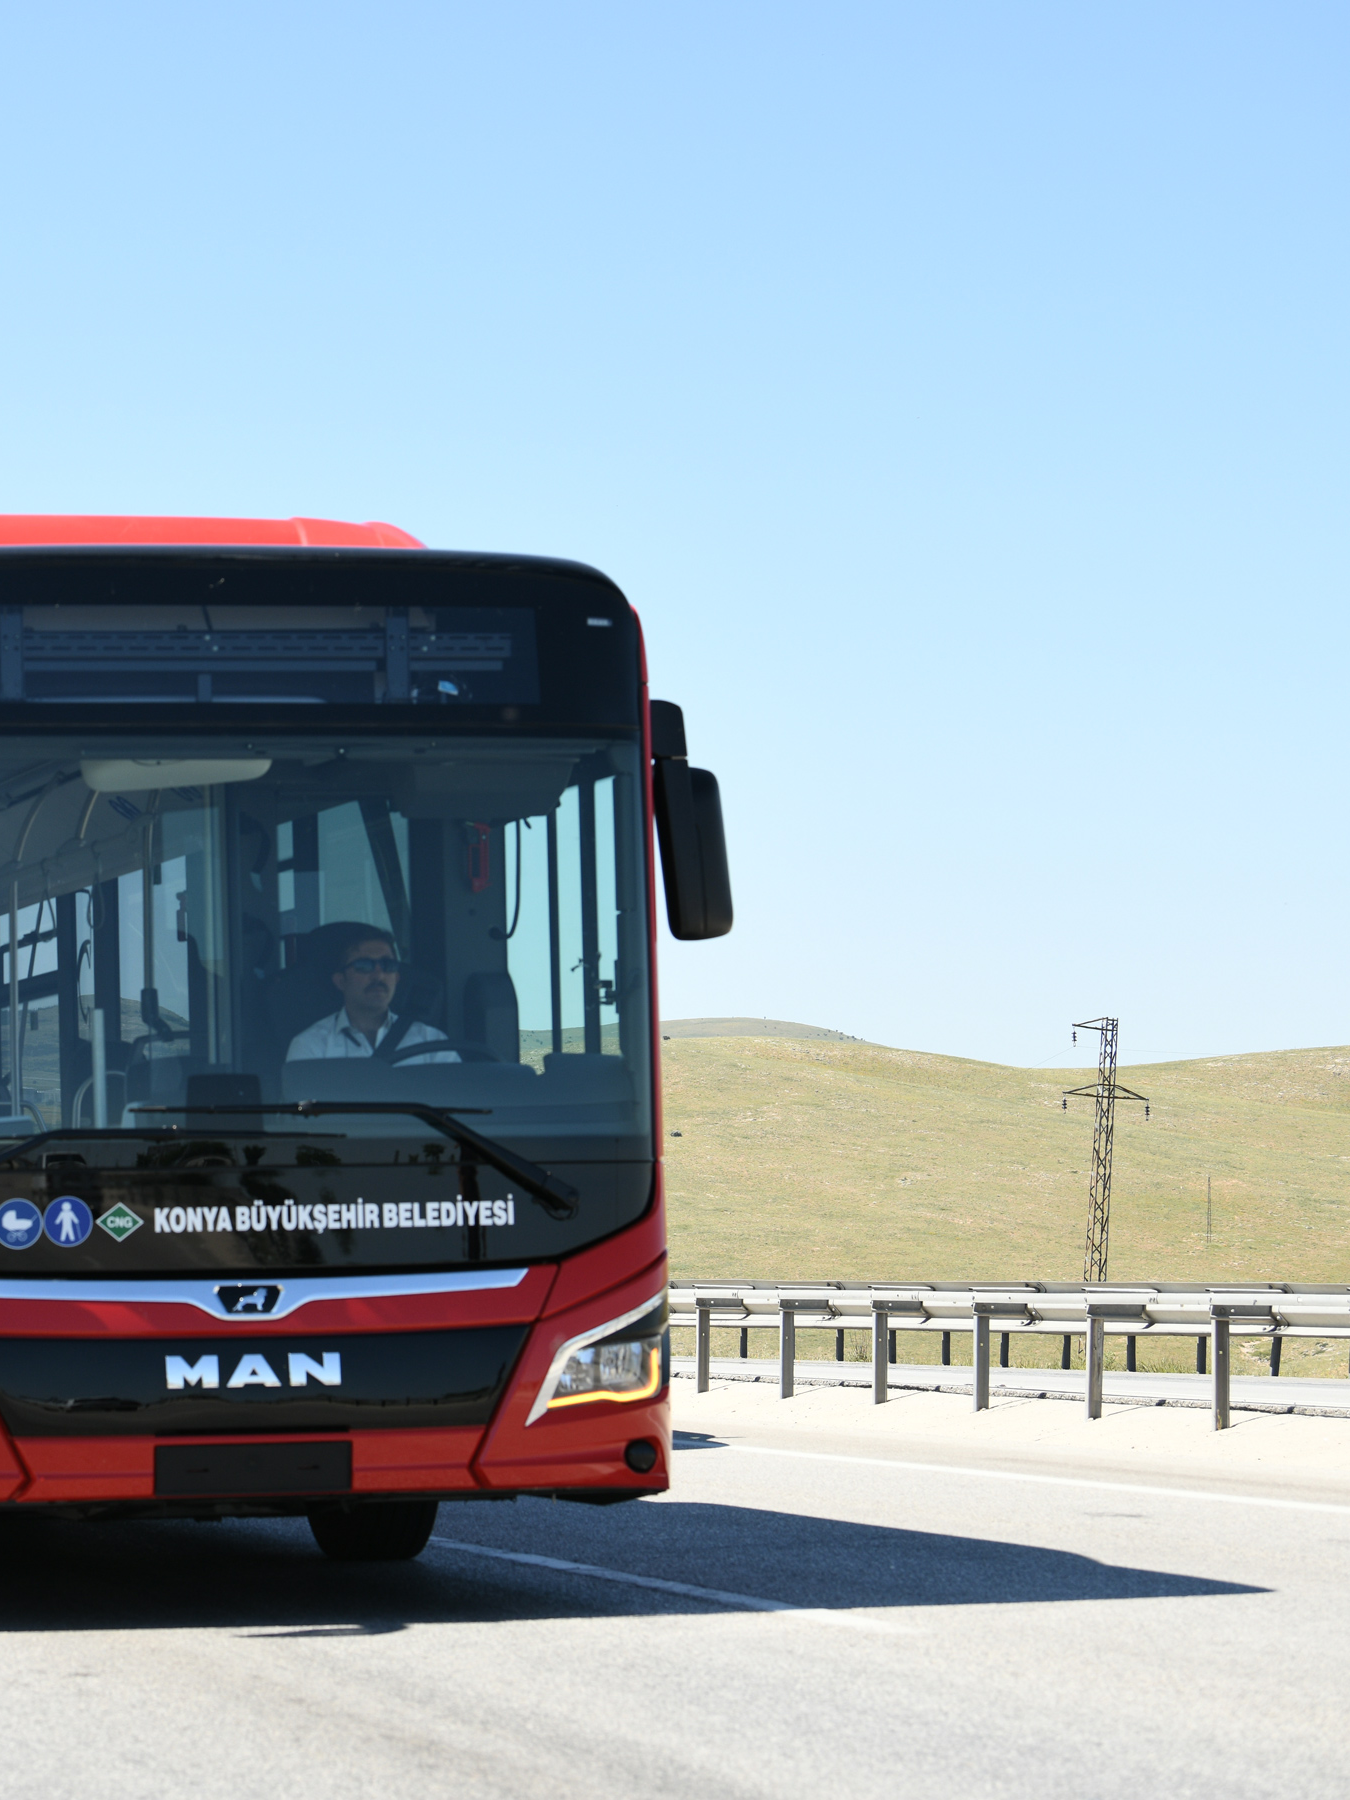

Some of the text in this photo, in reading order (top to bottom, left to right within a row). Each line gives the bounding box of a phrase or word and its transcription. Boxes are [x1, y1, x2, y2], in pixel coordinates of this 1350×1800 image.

[106, 1215, 134, 1229] CNG
[154, 1193, 515, 1234] KONYA BÜYÜKŞEHİR BELEDİYESİ
[165, 1352, 342, 1390] MAN
